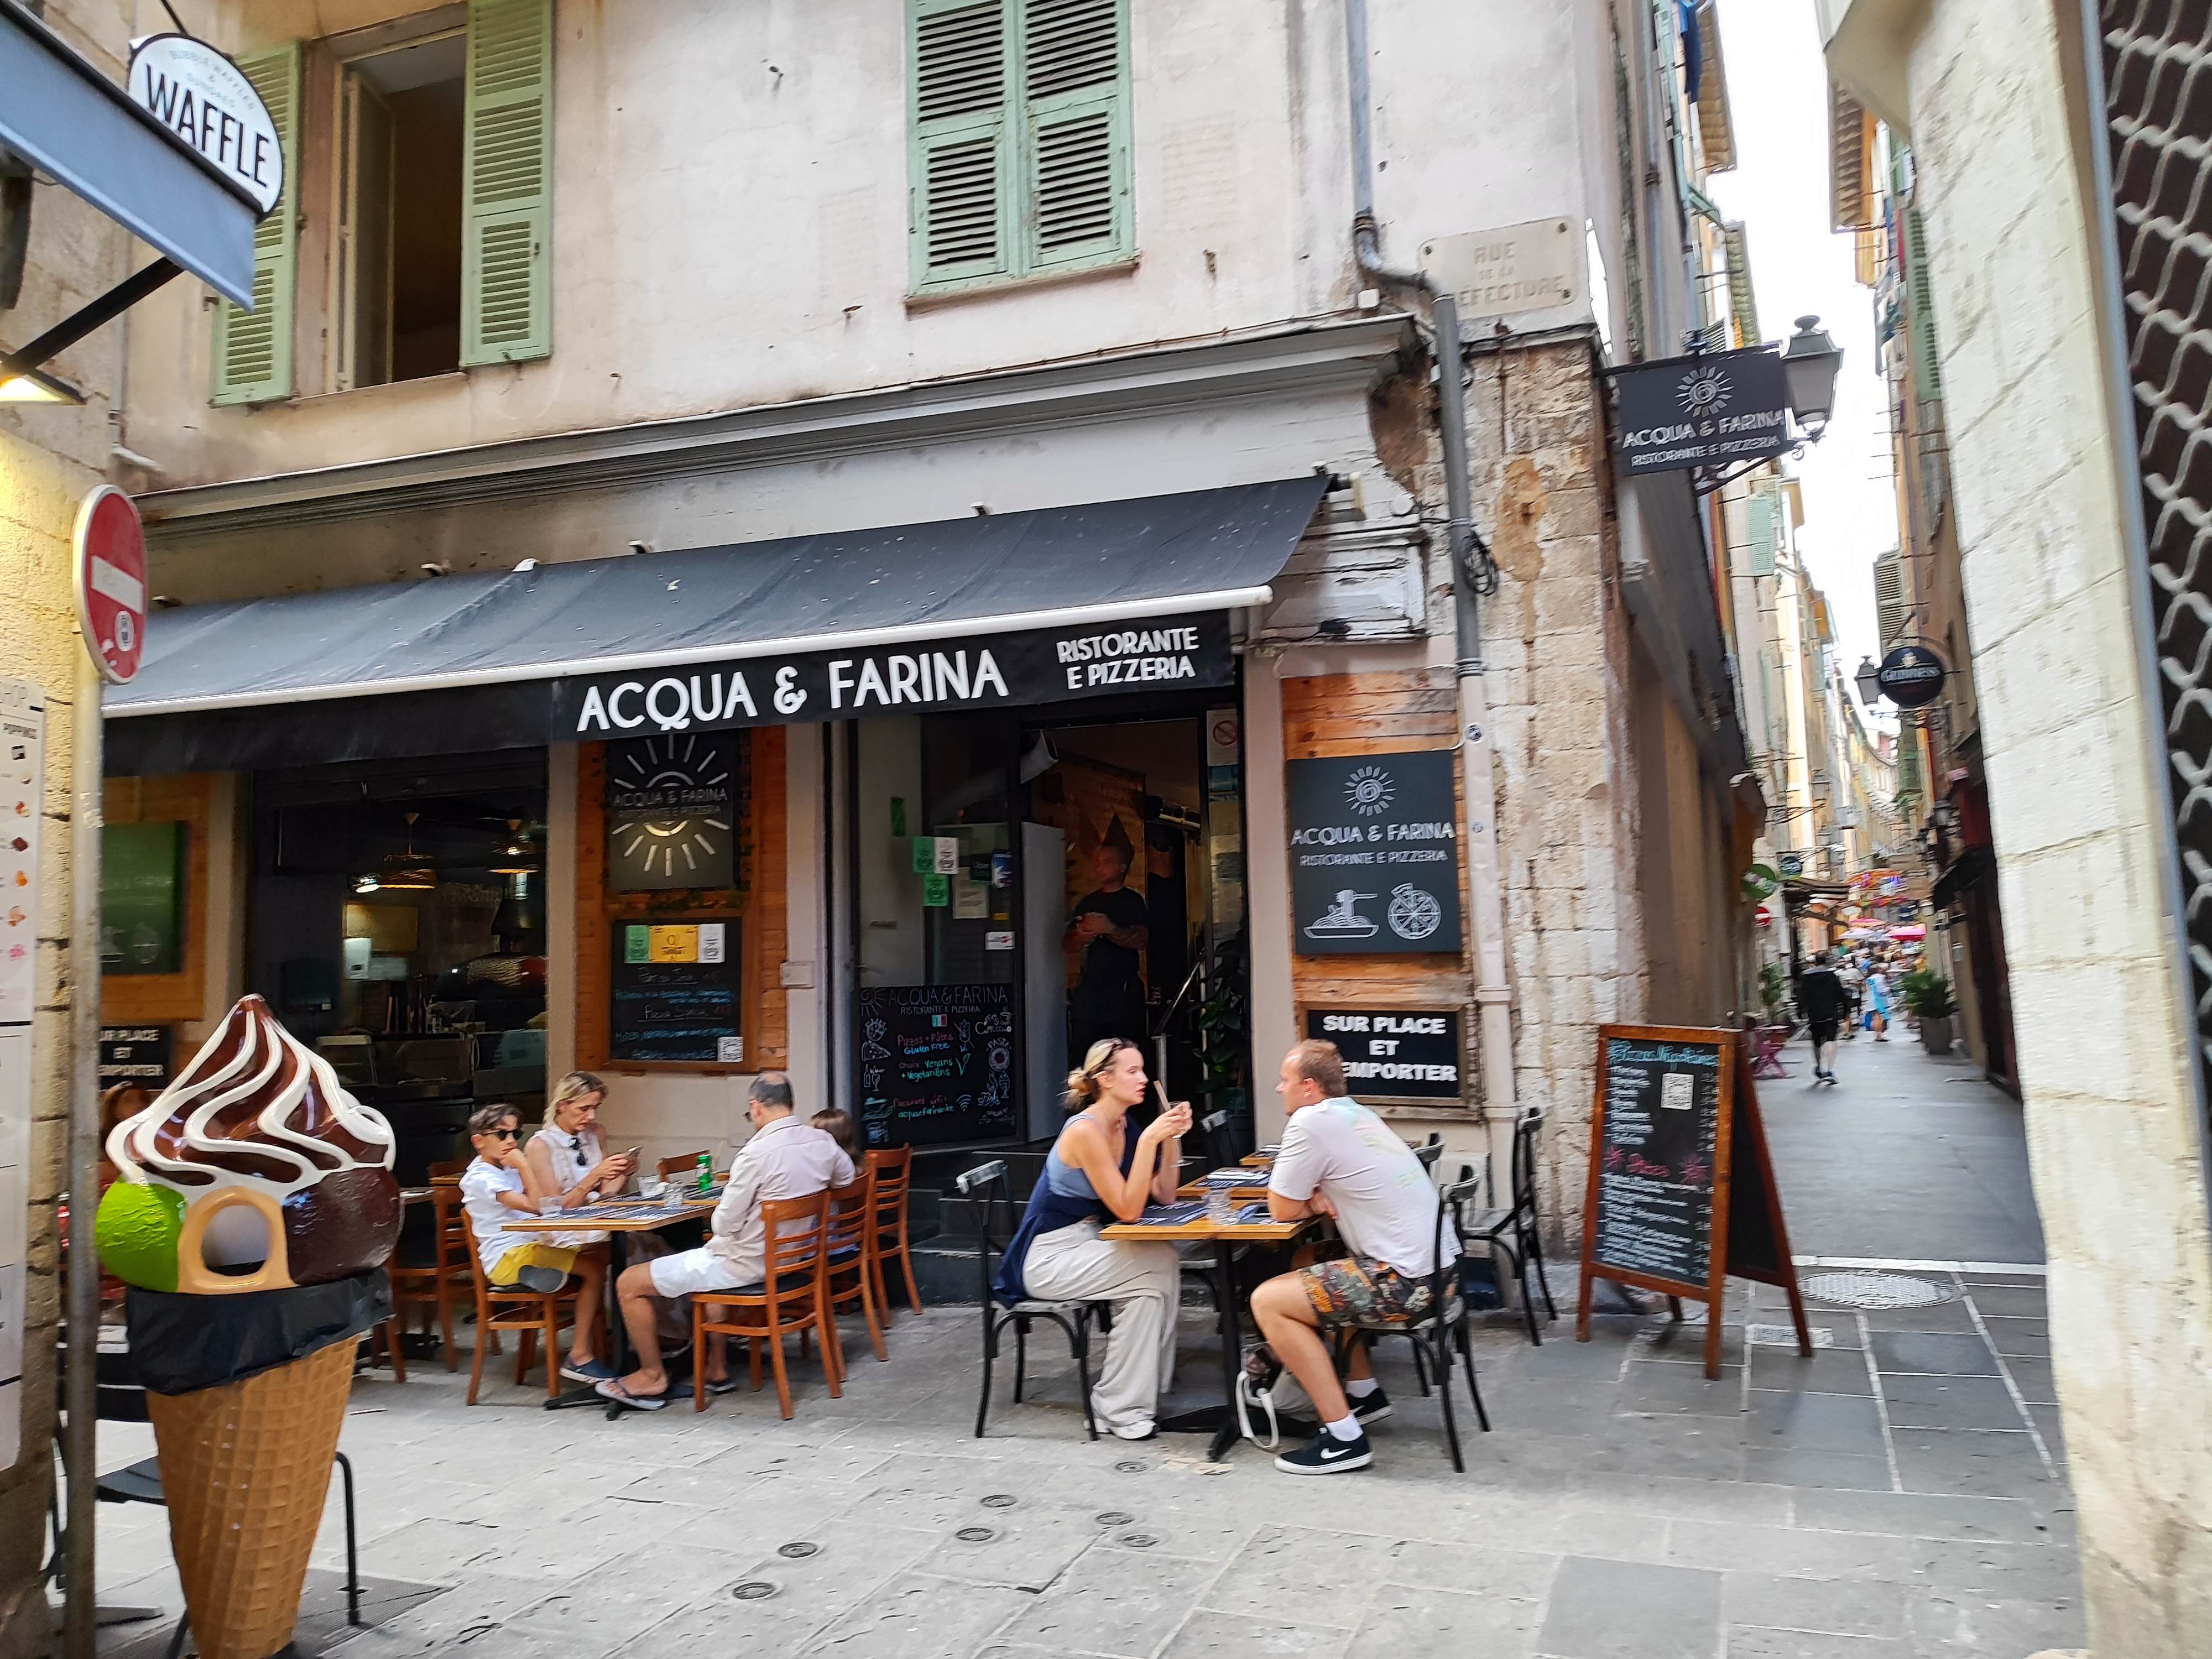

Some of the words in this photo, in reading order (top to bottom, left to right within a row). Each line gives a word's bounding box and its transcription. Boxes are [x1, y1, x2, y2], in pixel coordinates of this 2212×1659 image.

[146, 64, 268, 187] WAFFLE
[1473, 241, 1516, 265] RUE
[1621, 422, 1697, 448] ACQUA
[1699, 420, 1715, 437] &
[1718, 409, 1786, 435] FARINA
[1632, 445, 1709, 467] RISTORANTE
[1720, 435, 1781, 452] PIZZERIA
[1056, 627, 1199, 663] RISTORANTE
[1066, 666, 1083, 690] E
[1087, 655, 1196, 686] PIZZERIA
[576, 671, 759, 732] ACQUA
[773, 666, 808, 714] &
[828, 649, 1010, 709] FARINA
[1290, 826, 1364, 846] ACQUA
[1367, 825, 1383, 842] &
[1387, 822, 1456, 841] FARINA
[1300, 852, 1375, 867] RISTORANTE
[1376, 852, 1386, 864] E
[1388, 849, 1448, 863] PIZZERIA
[889, 988, 939, 1006] ACQUA
[941, 987, 952, 1005] &
[954, 985, 1009, 1004] FARINA
[900, 1005, 942, 1015] RISTORANTE
[951, 1005, 980, 1014] PIZZERIA
[1323, 1015, 1370, 1032] SUR
[1373, 1016, 1447, 1034] PLACE
[1369, 1039, 1400, 1056] ET
[1341, 1061, 1458, 1082] EMPORTER
